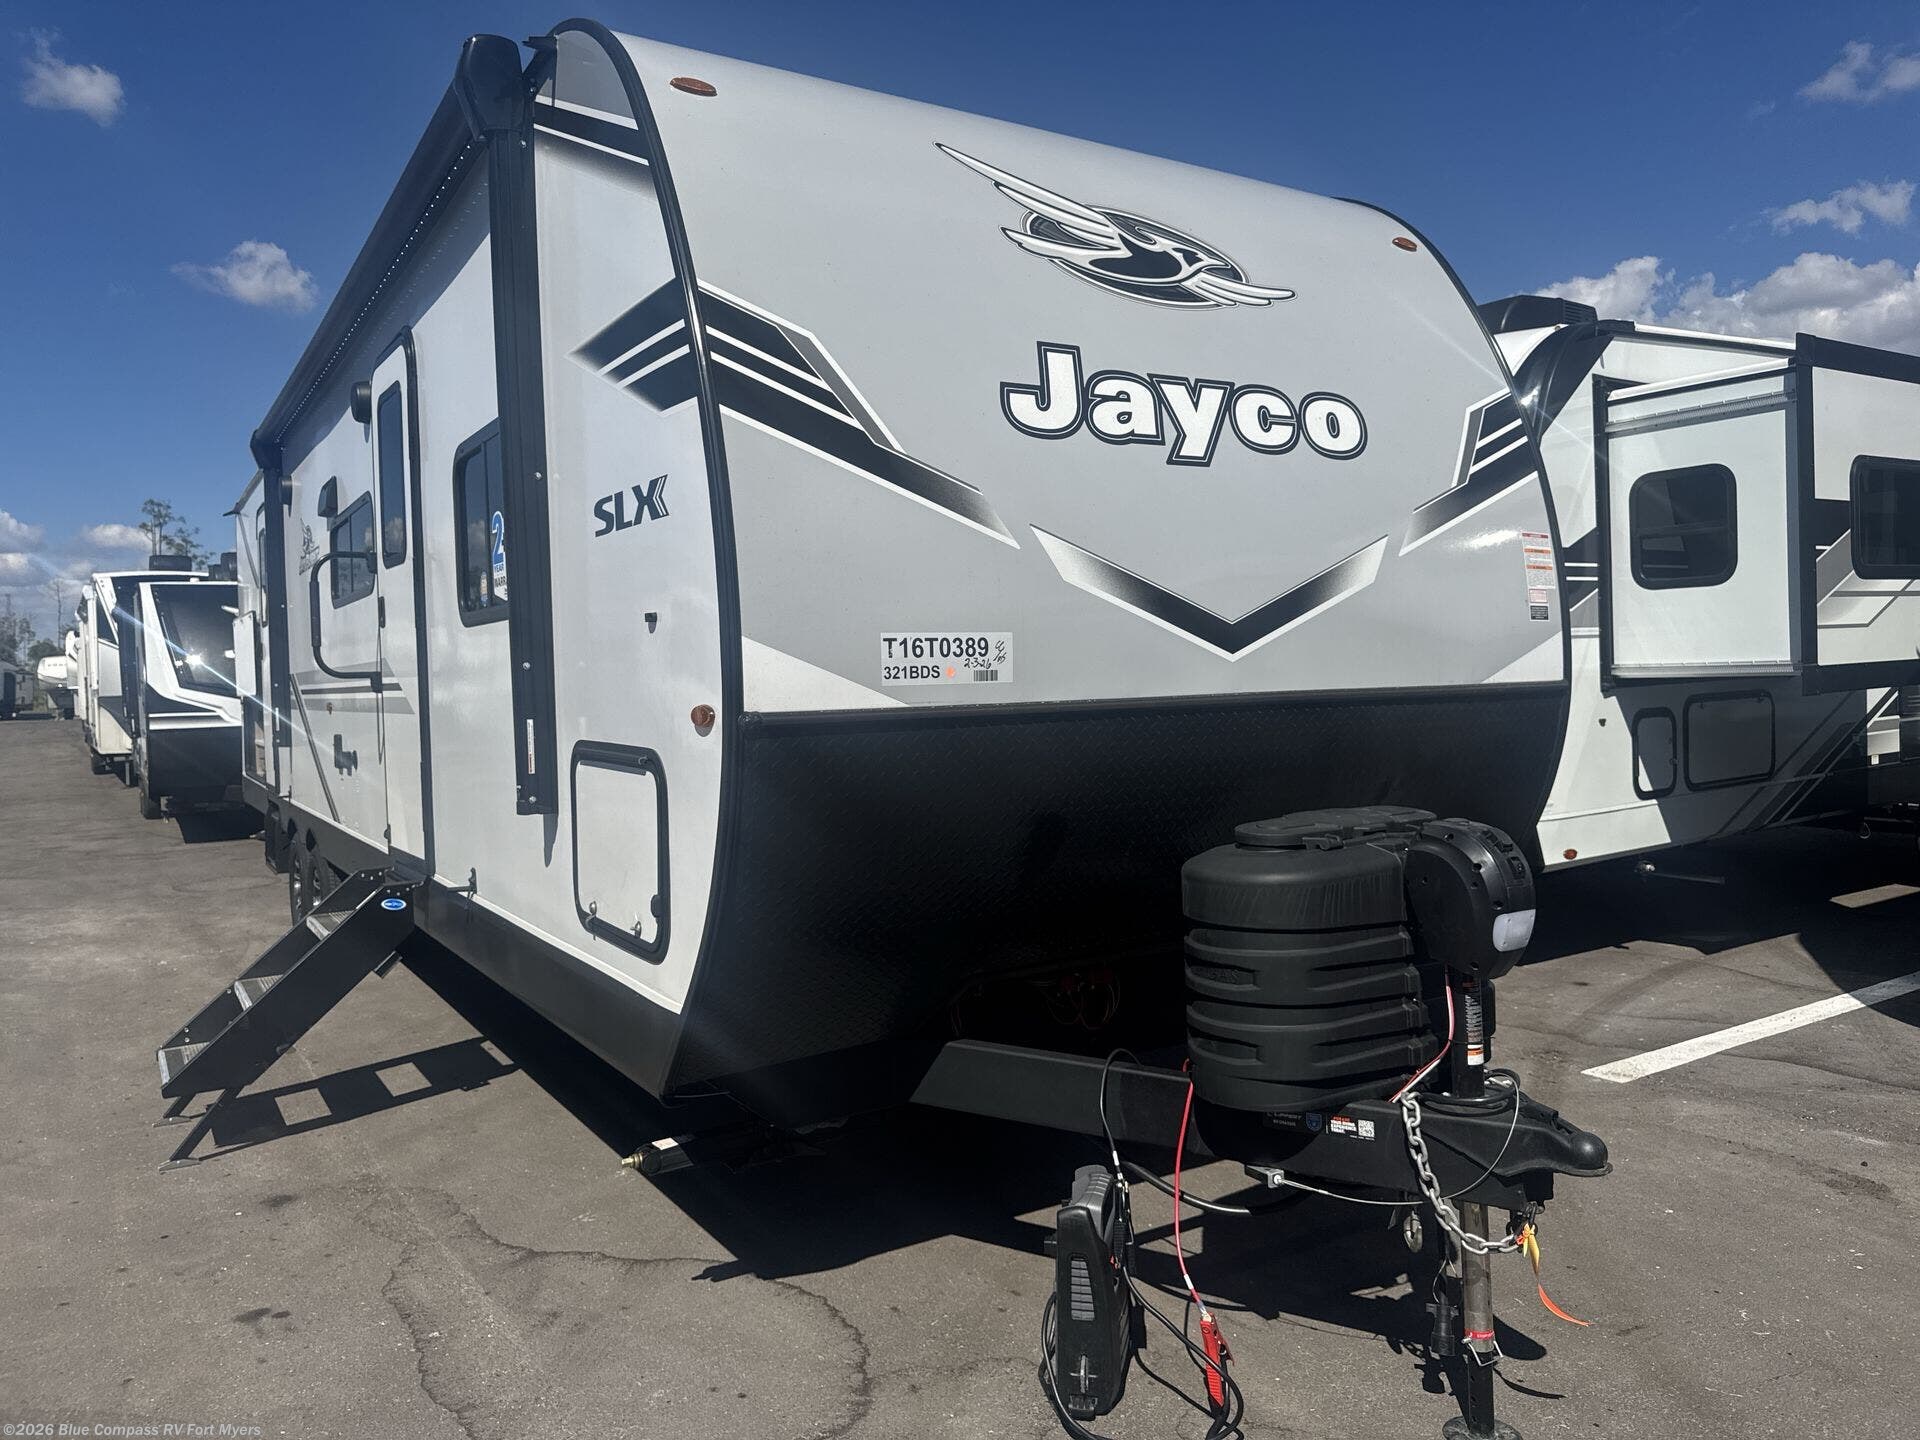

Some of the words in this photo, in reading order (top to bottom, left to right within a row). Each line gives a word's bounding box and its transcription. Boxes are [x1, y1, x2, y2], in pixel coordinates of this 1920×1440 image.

[1000, 341, 1368, 467] Jayco
[594, 475, 669, 537] SLX
[883, 637, 989, 658] T16T0389
[884, 665, 940, 680] 321BDS
